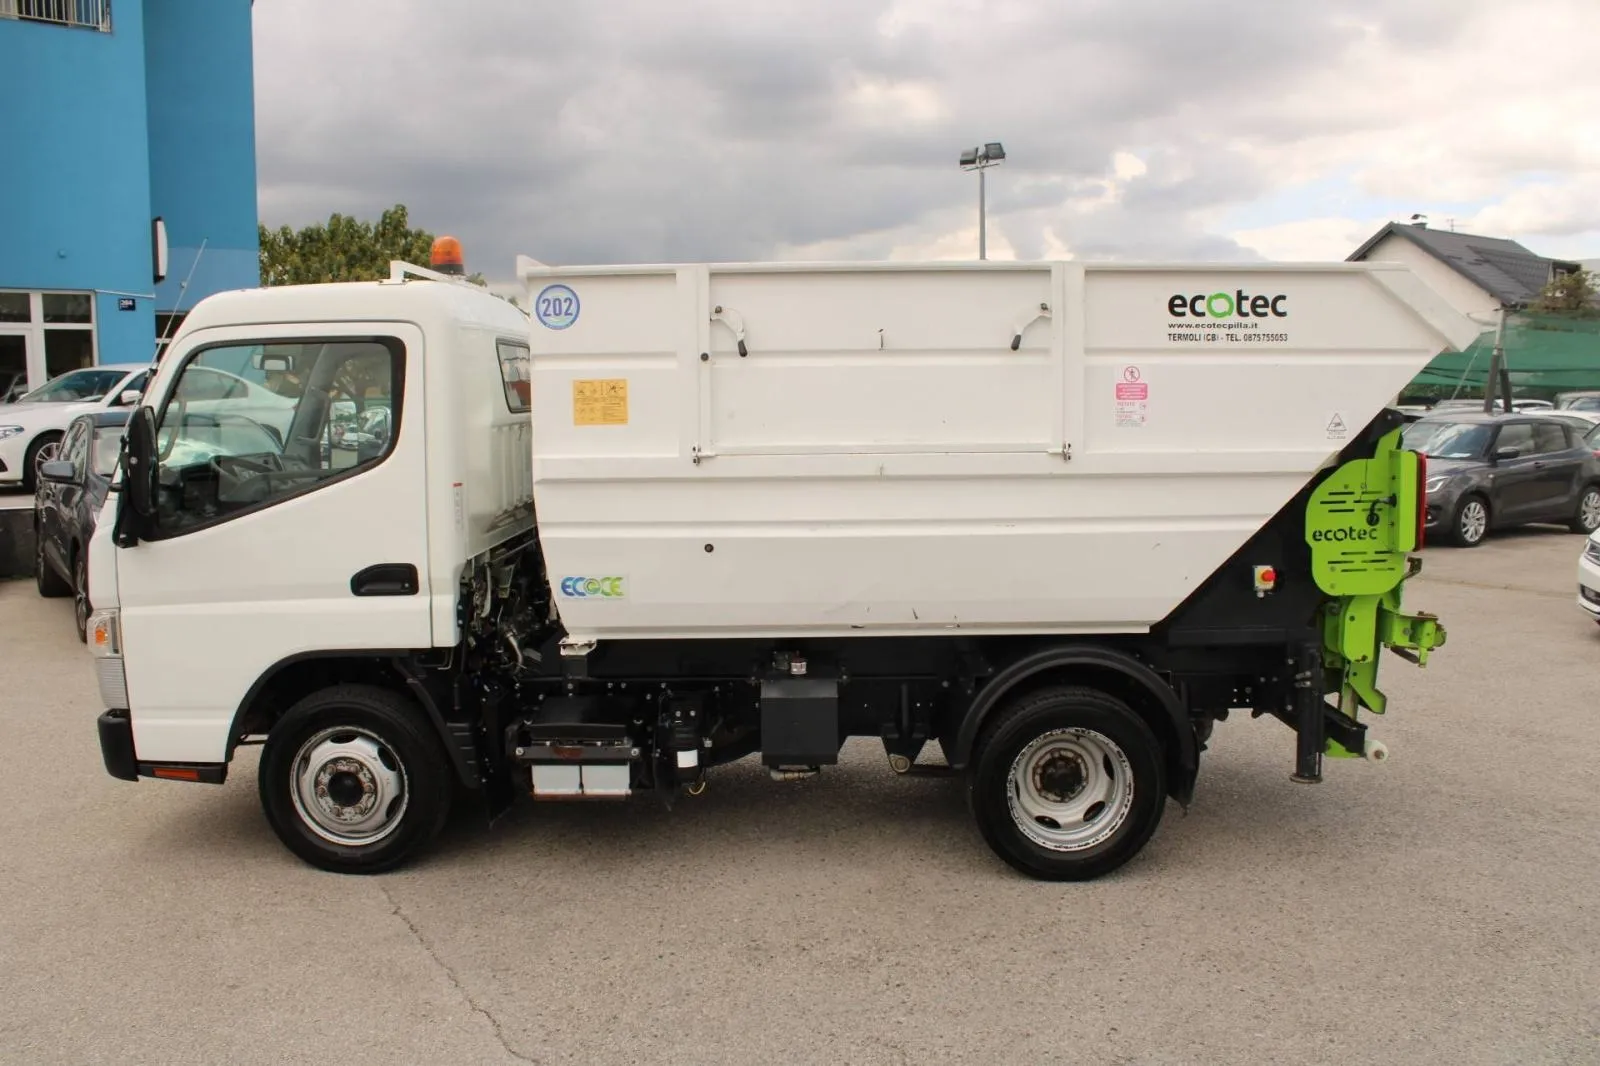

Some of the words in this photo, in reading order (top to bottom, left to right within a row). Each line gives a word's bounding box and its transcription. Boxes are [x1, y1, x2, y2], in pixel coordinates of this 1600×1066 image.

[541, 297, 573, 317] 202
[1168, 289, 1287, 318] ecotec
[1168, 322, 1258, 330] www.ecotecpilla.it
[1168, 333, 1201, 341] TERMOLI
[1226, 333, 1241, 341] TEL.
[1312, 526, 1378, 542] ecotec
